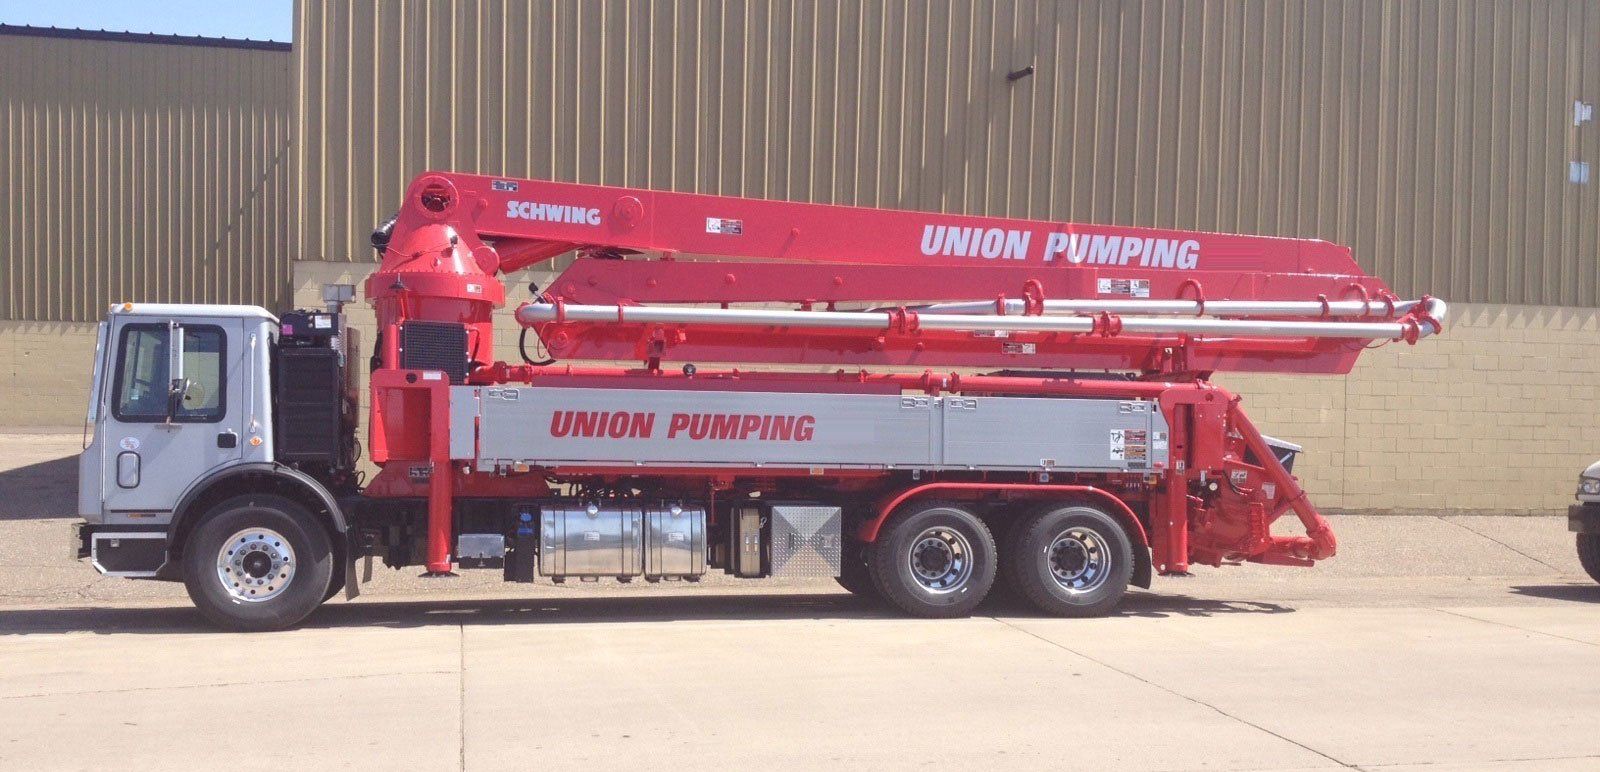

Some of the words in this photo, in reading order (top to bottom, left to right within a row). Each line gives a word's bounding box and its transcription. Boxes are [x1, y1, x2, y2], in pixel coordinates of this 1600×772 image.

[507, 200, 601, 226] SCHWING
[920, 225, 1031, 260] UNION
[1043, 233, 1200, 270] PUMPING
[550, 411, 655, 439] UNION
[668, 413, 816, 442] PUMPING
